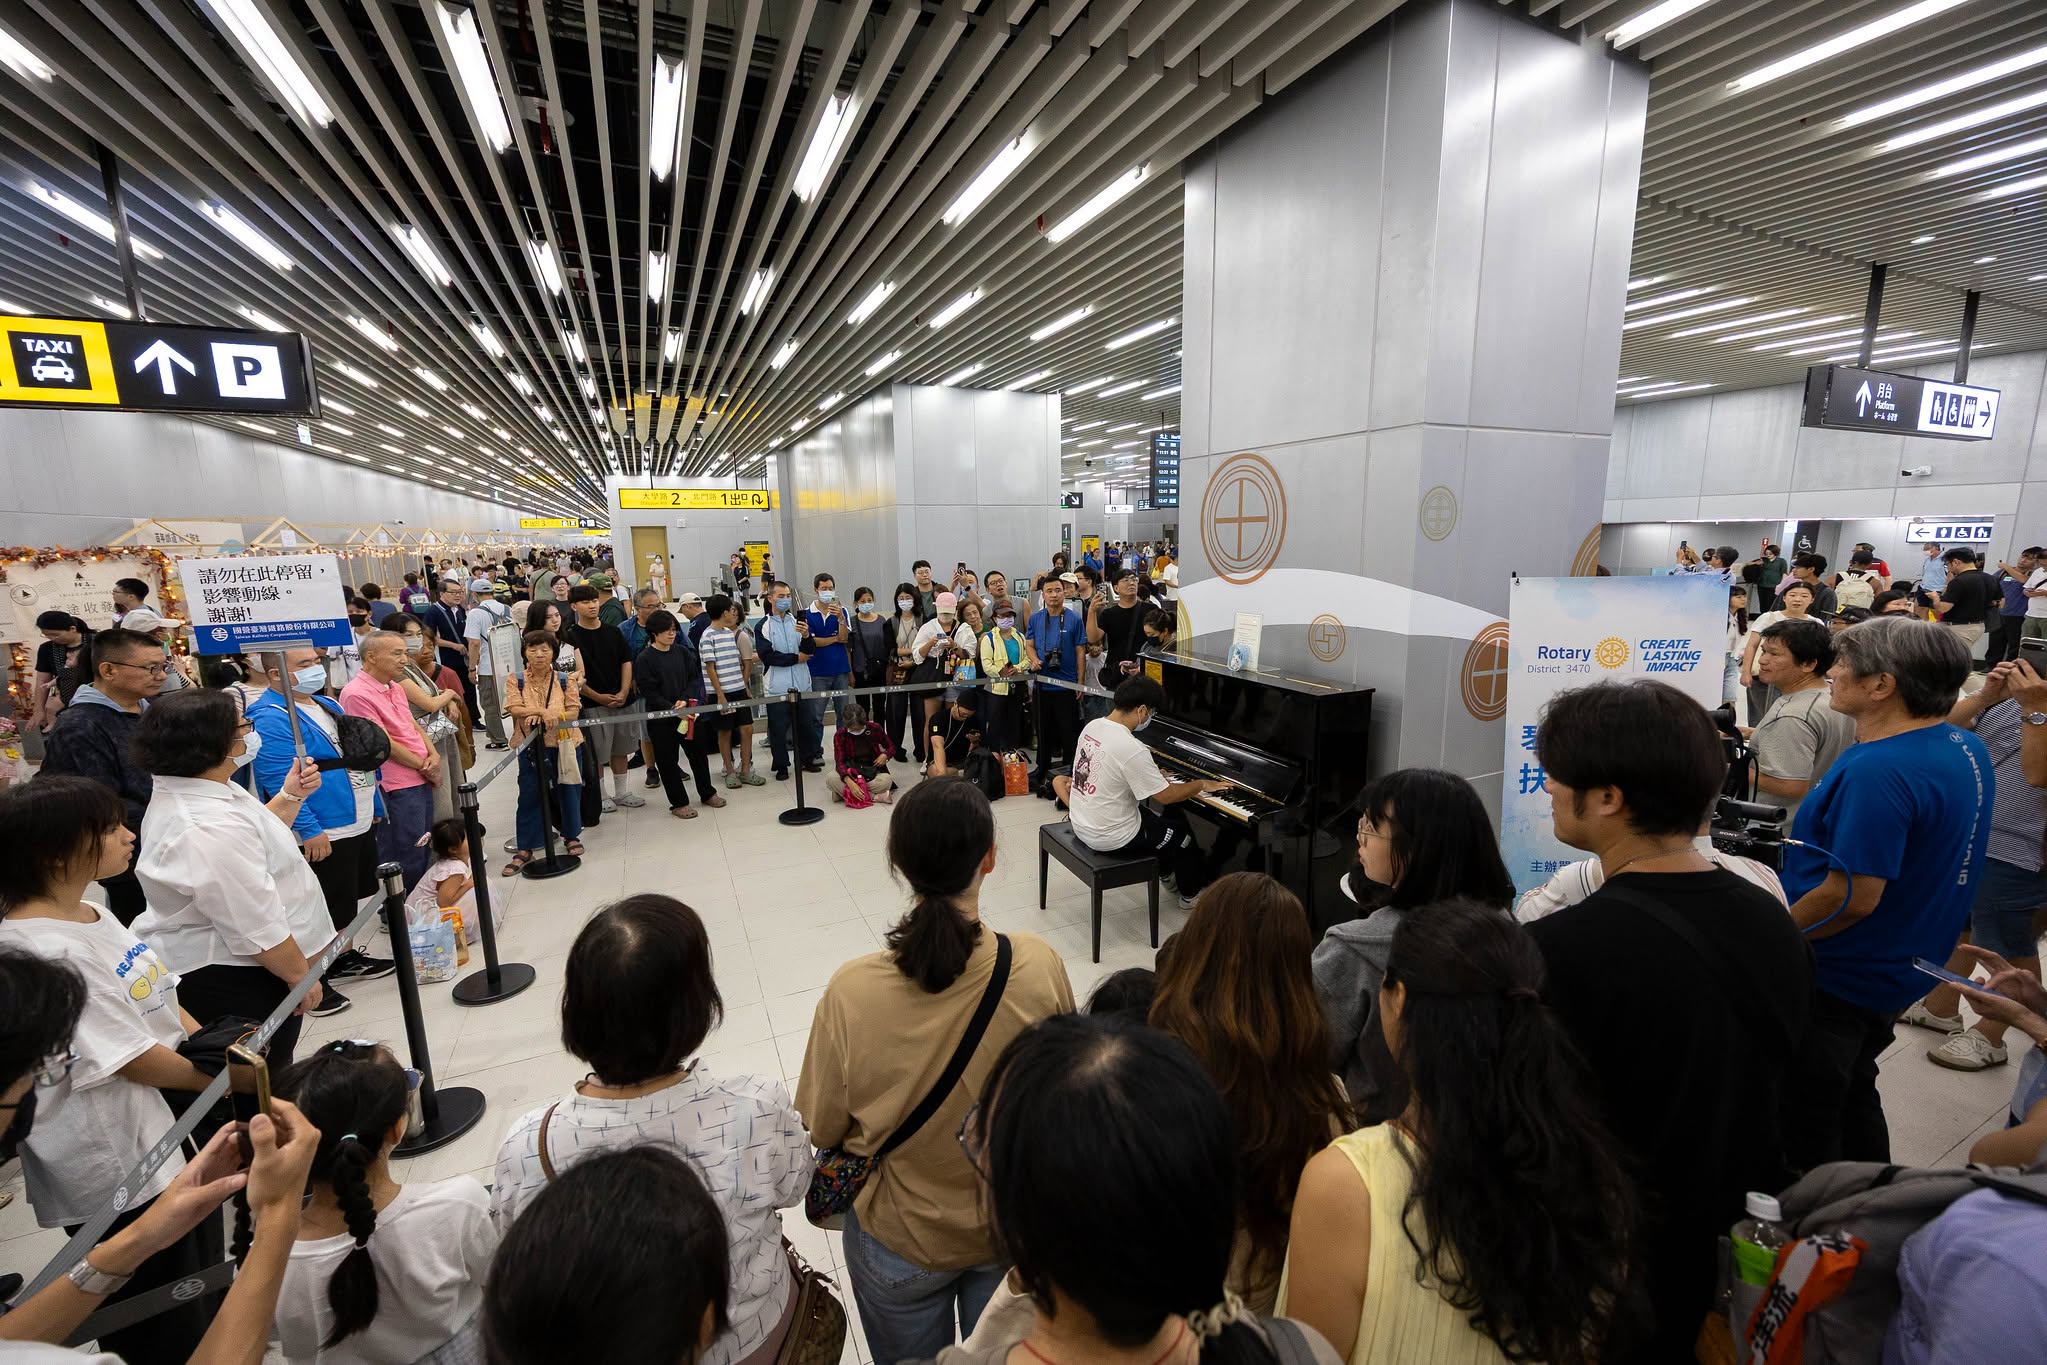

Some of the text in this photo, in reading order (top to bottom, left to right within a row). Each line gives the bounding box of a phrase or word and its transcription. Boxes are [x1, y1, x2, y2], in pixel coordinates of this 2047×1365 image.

[21, 338, 73, 354] TAXI
[231, 355, 262, 386] P
[1875, 400, 1895, 411] Platform
[671, 492, 681, 506] 2
[720, 493, 728, 505] 1
[1063, 526, 1068, 539] 1
[198, 563, 326, 585] 請勿在此停留，
[202, 585, 293, 605] 影響動線。
[232, 620, 336, 634] 國營臺灣鐵路股份有限公司
[1639, 639, 1691, 649] CREATE
[1538, 646, 1591, 661] Rotary
[1643, 650, 1702, 661] LASTING
[1527, 664, 1591, 673] District 3470
[1645, 662, 1697, 672] IMPACT
